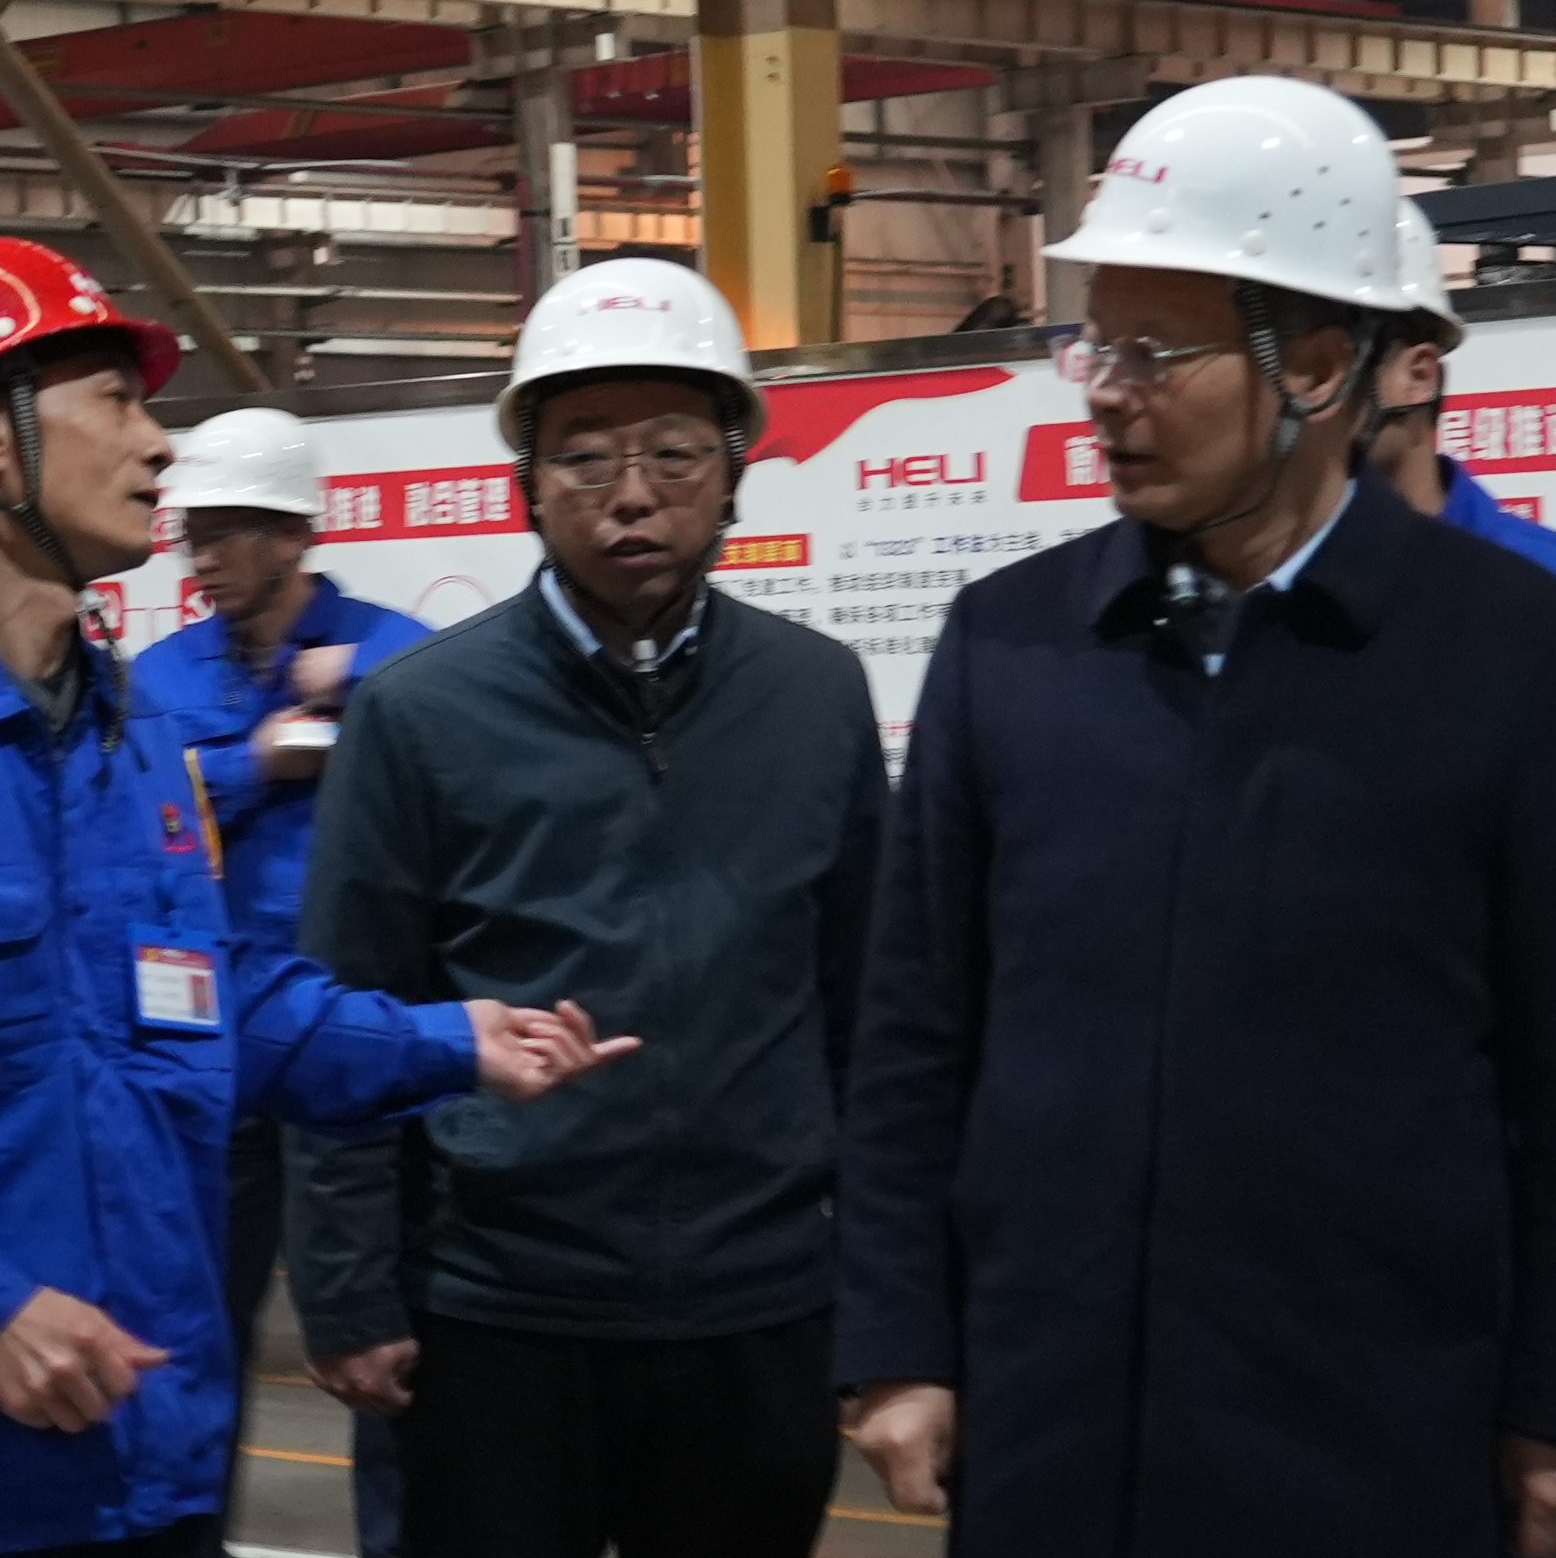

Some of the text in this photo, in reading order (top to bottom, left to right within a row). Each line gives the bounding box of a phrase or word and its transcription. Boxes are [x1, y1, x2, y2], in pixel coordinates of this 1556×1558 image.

[1106, 157, 1169, 185] ELI
[855, 451, 986, 490] HELI
[404, 477, 511, 527] 融合管理
